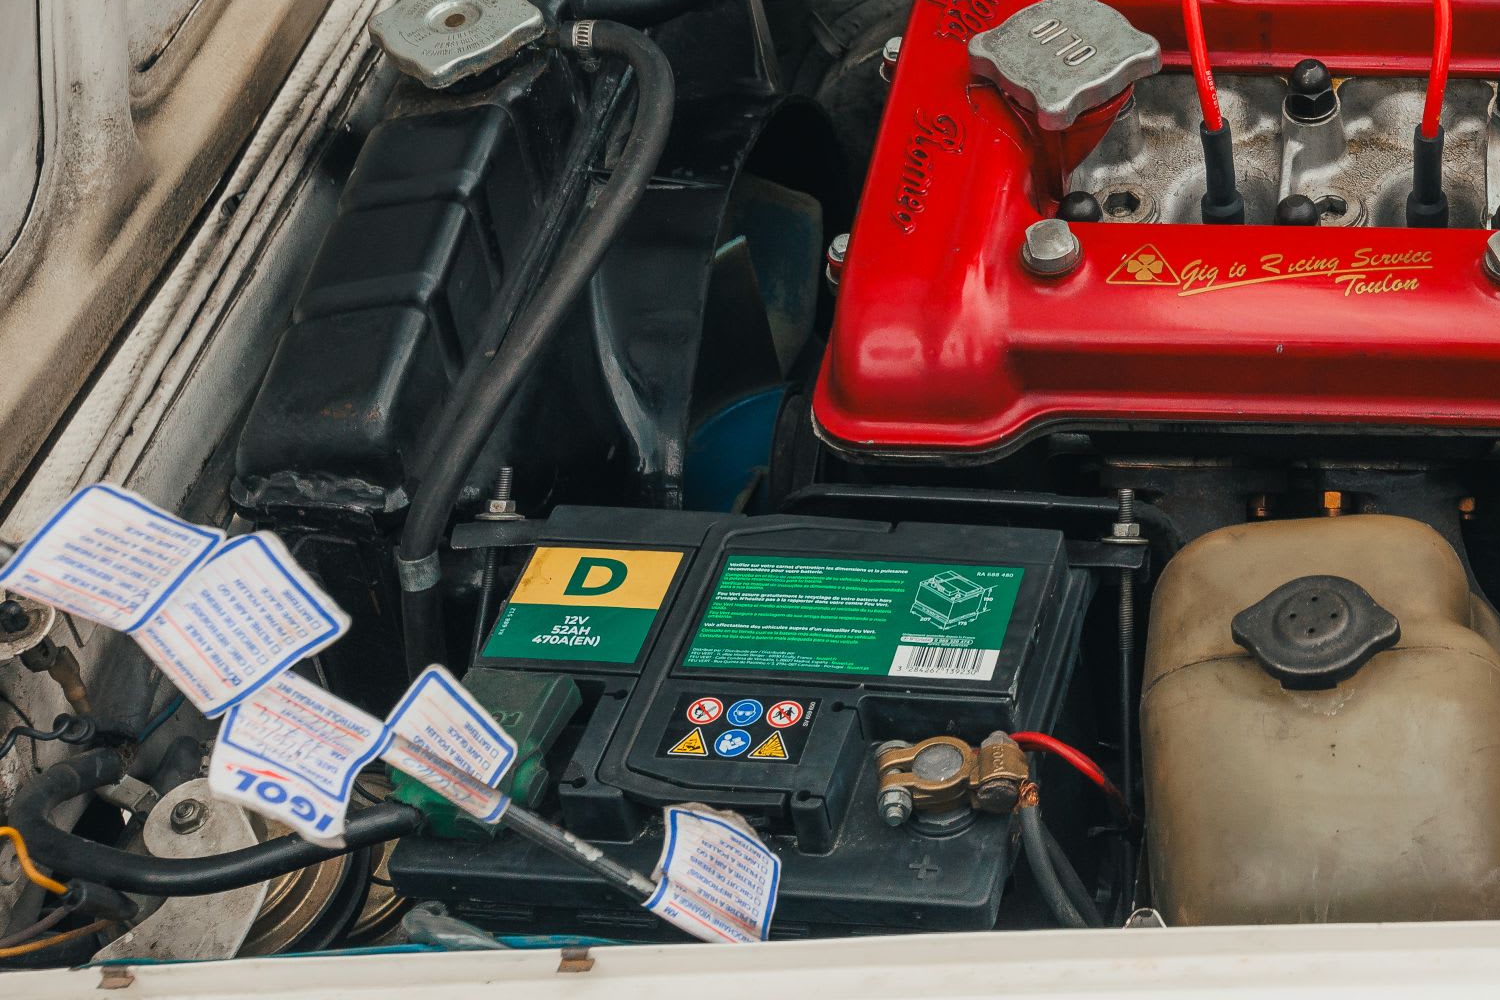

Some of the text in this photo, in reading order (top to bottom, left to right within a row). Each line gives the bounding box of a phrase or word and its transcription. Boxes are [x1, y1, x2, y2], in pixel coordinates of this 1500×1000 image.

[1028, 18, 1097, 66] OLIO
[1335, 274, 1420, 296] Toulon
[563, 557, 628, 596] D
[551, 625, 590, 635] 52AH
[564, 615, 590, 625] 12V
[531, 635, 600, 647] 470A(EN)
[461, 721, 492, 751] BATTERIE
[234, 768, 333, 833] IGOL
[662, 904, 678, 918] KM
[677, 895, 713, 921] VIDANGE
